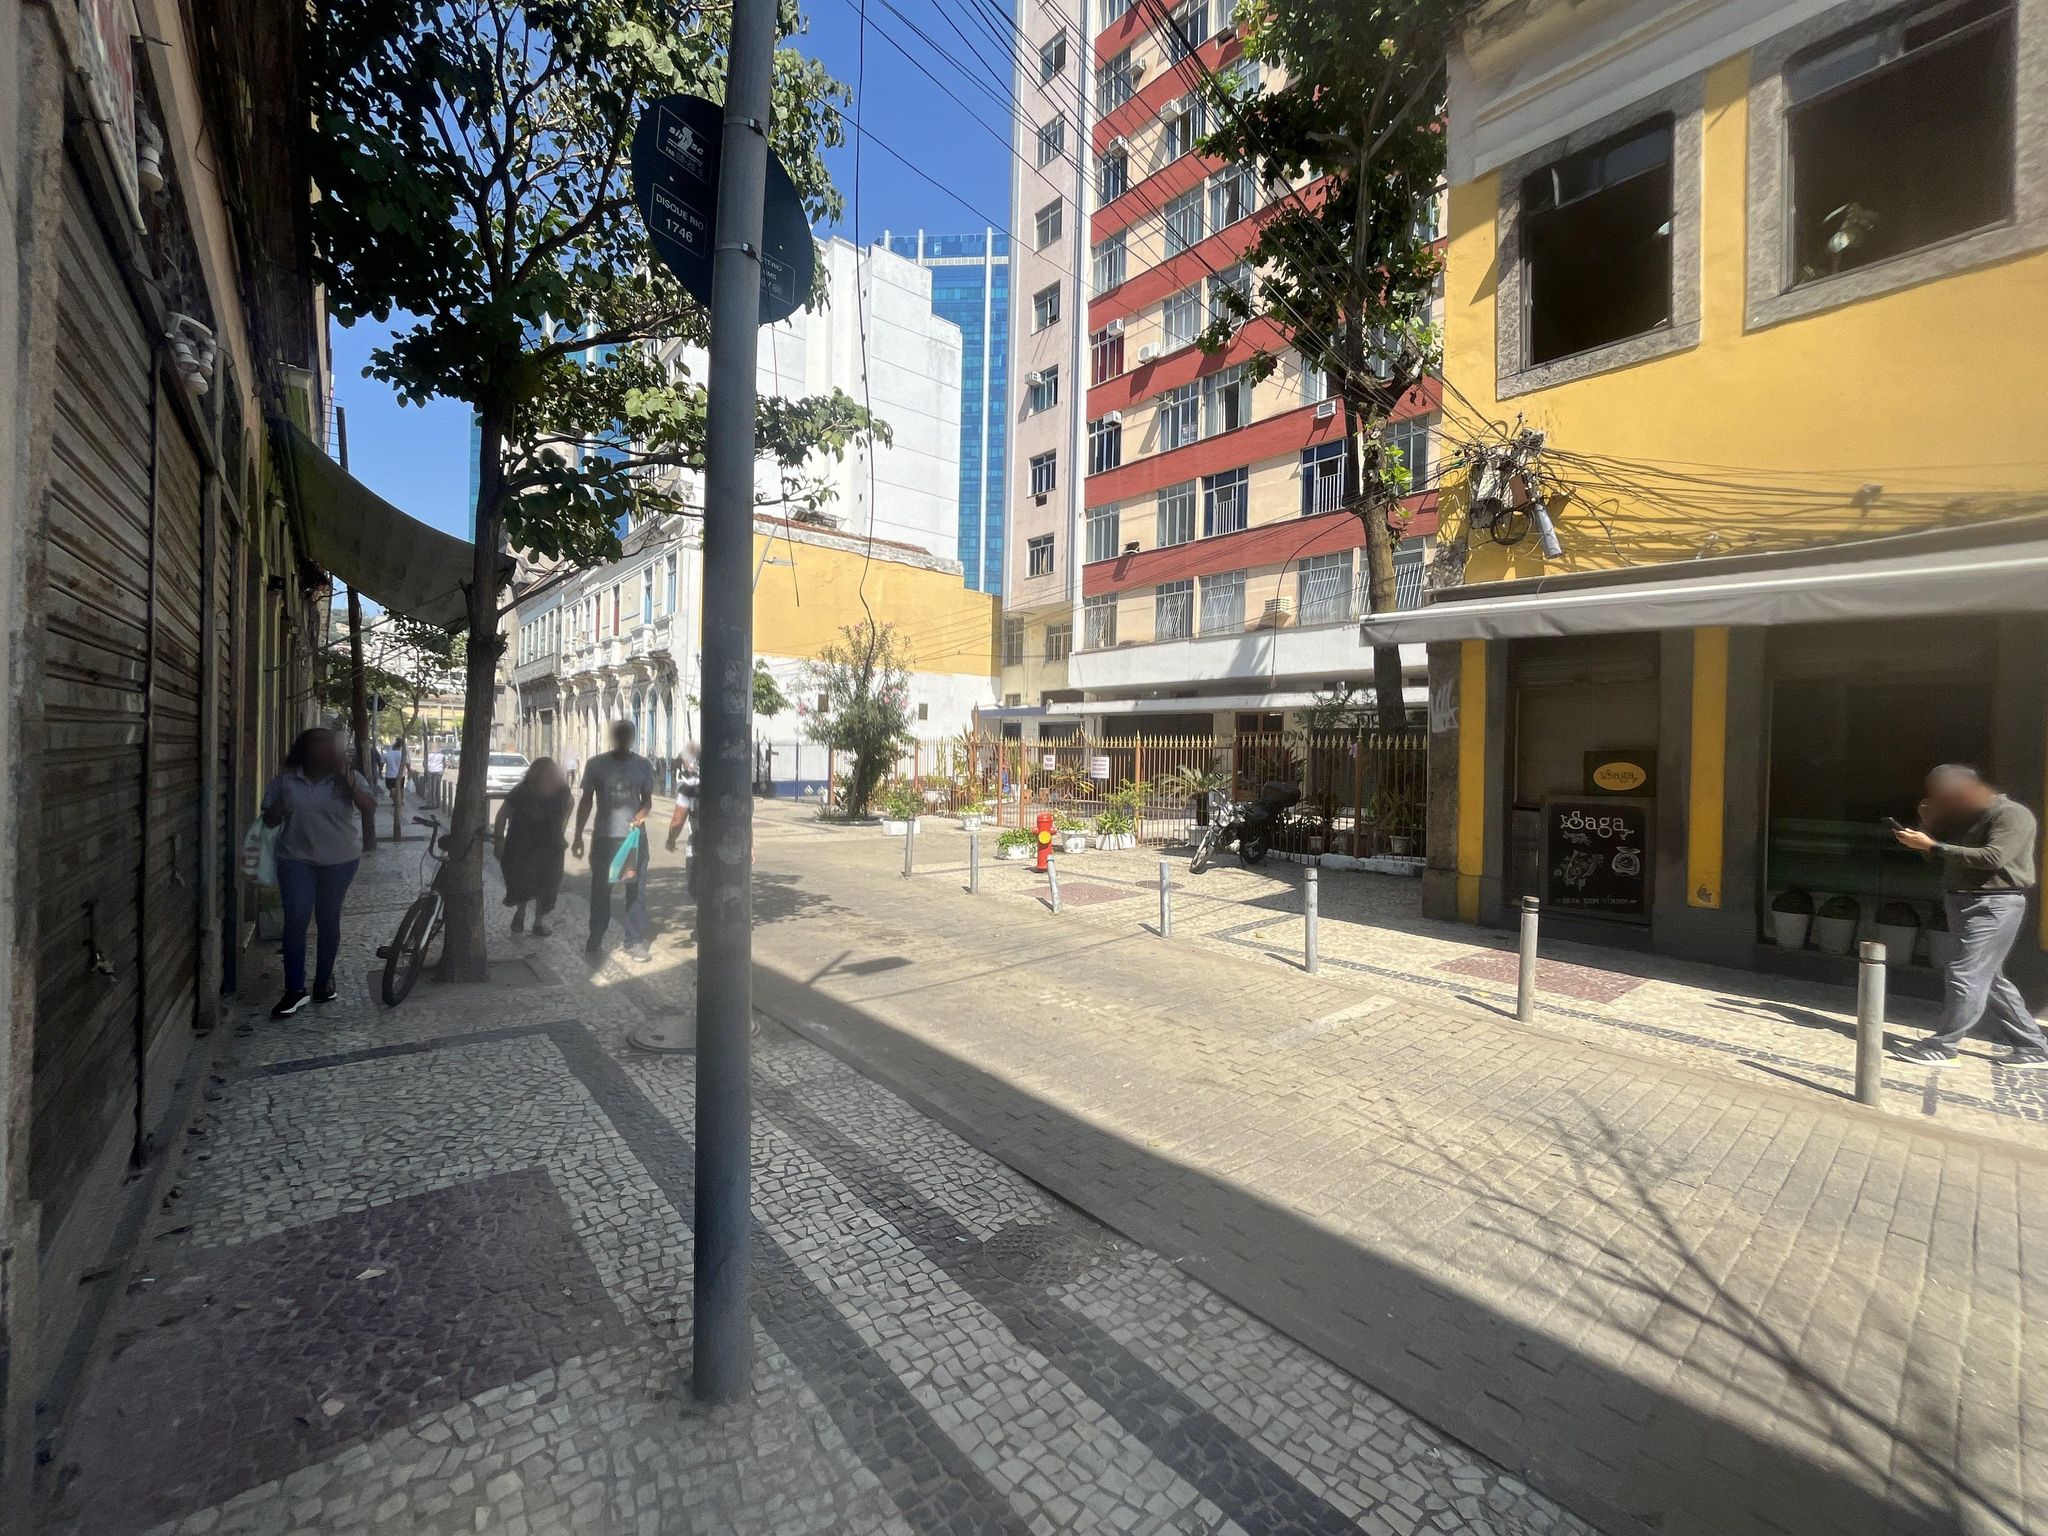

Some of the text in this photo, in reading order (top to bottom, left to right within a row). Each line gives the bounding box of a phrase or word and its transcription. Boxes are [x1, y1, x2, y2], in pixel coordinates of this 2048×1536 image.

[656, 193, 704, 230] DISQUE RIO
[666, 218, 693, 243] 1746
[1600, 768, 1639, 785] Saga
[1560, 810, 1635, 840] Saga
